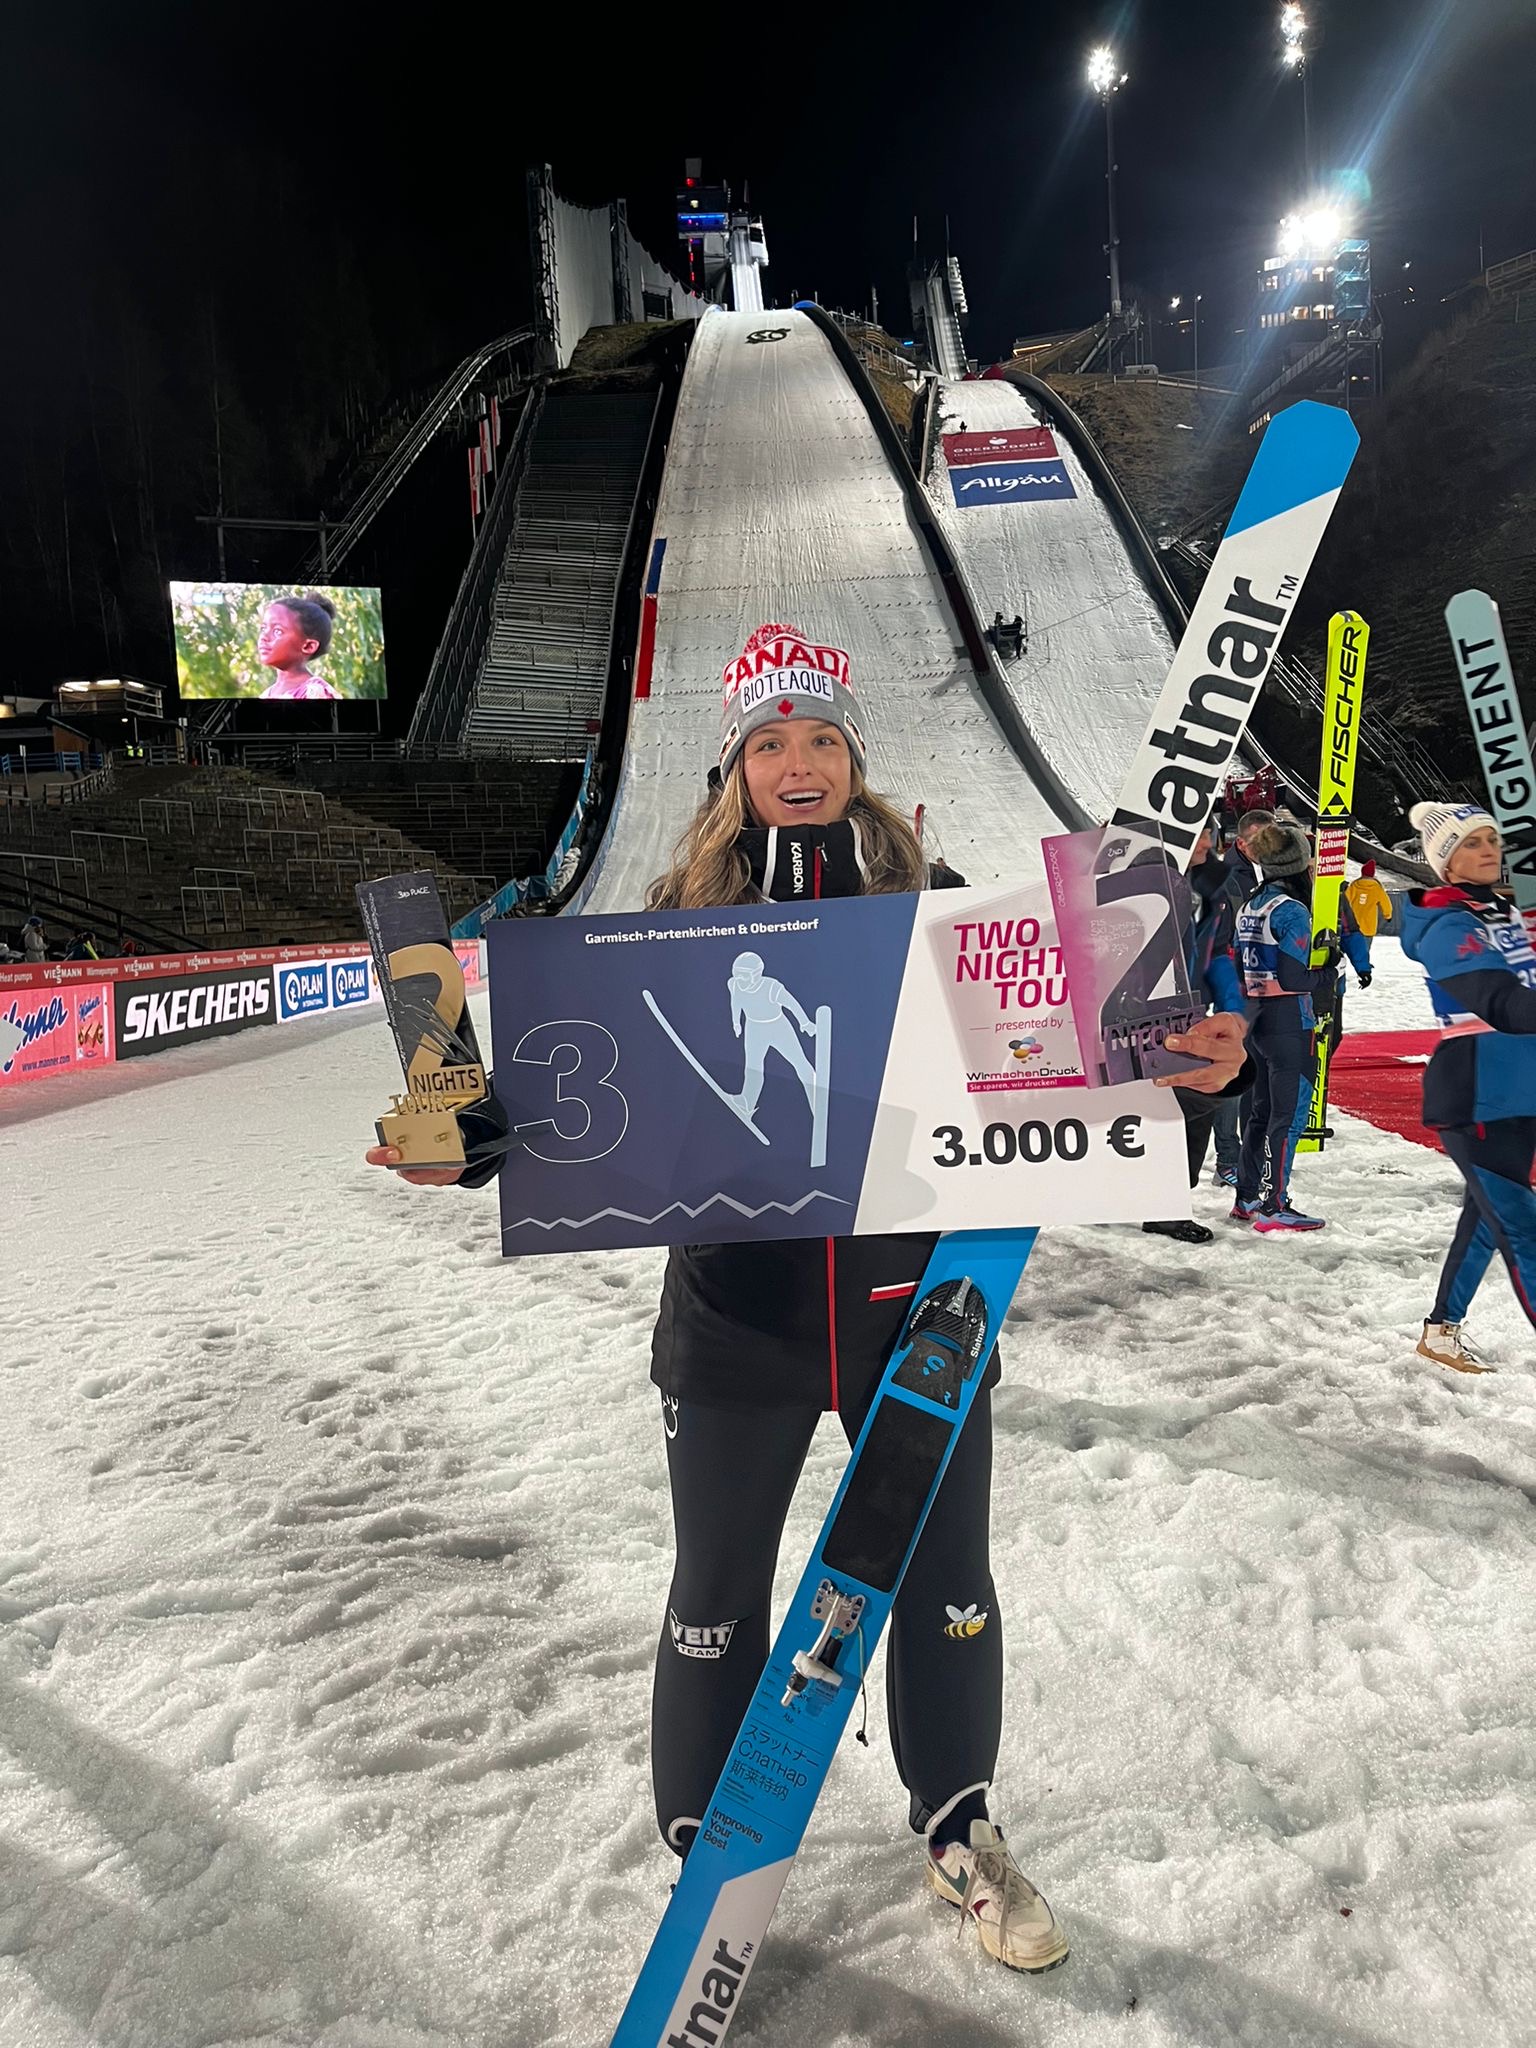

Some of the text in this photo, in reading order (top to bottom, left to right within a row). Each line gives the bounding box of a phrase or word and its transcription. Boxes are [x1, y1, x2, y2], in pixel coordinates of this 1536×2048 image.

[959, 474, 1063, 493] Allgäu
[1276, 574, 1299, 601] TM
[743, 670, 831, 707] BIOTEAQUE
[1330, 626, 1362, 788] FISCHER
[1458, 638, 1536, 876] AUGMENT
[1319, 839, 1347, 850] Zeitung
[1321, 829, 1348, 839] Kronen
[790, 841, 804, 894] KARBON
[1317, 863, 1344, 874] Zeitung
[1319, 854, 1345, 864] Kronen
[410, 886, 431, 895] PLACE
[585, 918, 819, 944] Garmisch-Partenkirchen & Oberstdorf
[954, 918, 1040, 951] TWO
[956, 946, 1067, 982] NIGHT
[1243, 946, 1259, 968] 46
[43, 965, 83, 984] VIESSMANN
[301, 974, 323, 997] PLAN
[347, 969, 366, 989] PLAN
[994, 977, 1069, 1010] TOU
[123, 978, 270, 1042] SKECHERS
[995, 1016, 1063, 1032] presented by
[413, 1068, 479, 1094] NIGHTS
[512, 1019, 629, 1164] 3
[983, 1083, 1010, 1091] sparen,
[1025, 1079, 1058, 1087] drucken!
[388, 1092, 448, 1116] TOUR
[932, 1115, 1145, 1167] 3.000 €
[970, 1320, 987, 1359] Slatnar
[671, 1620, 730, 1646] VEIT
[680, 1646, 717, 1657] TEAM
[745, 1724, 819, 1768] スラットナー
[738, 1740, 808, 1789] Слатнар
[708, 1819, 732, 1839] Your
[712, 1807, 763, 1844] Improving
[703, 1829, 729, 1850] Best
[741, 1941, 755, 1960] TM
